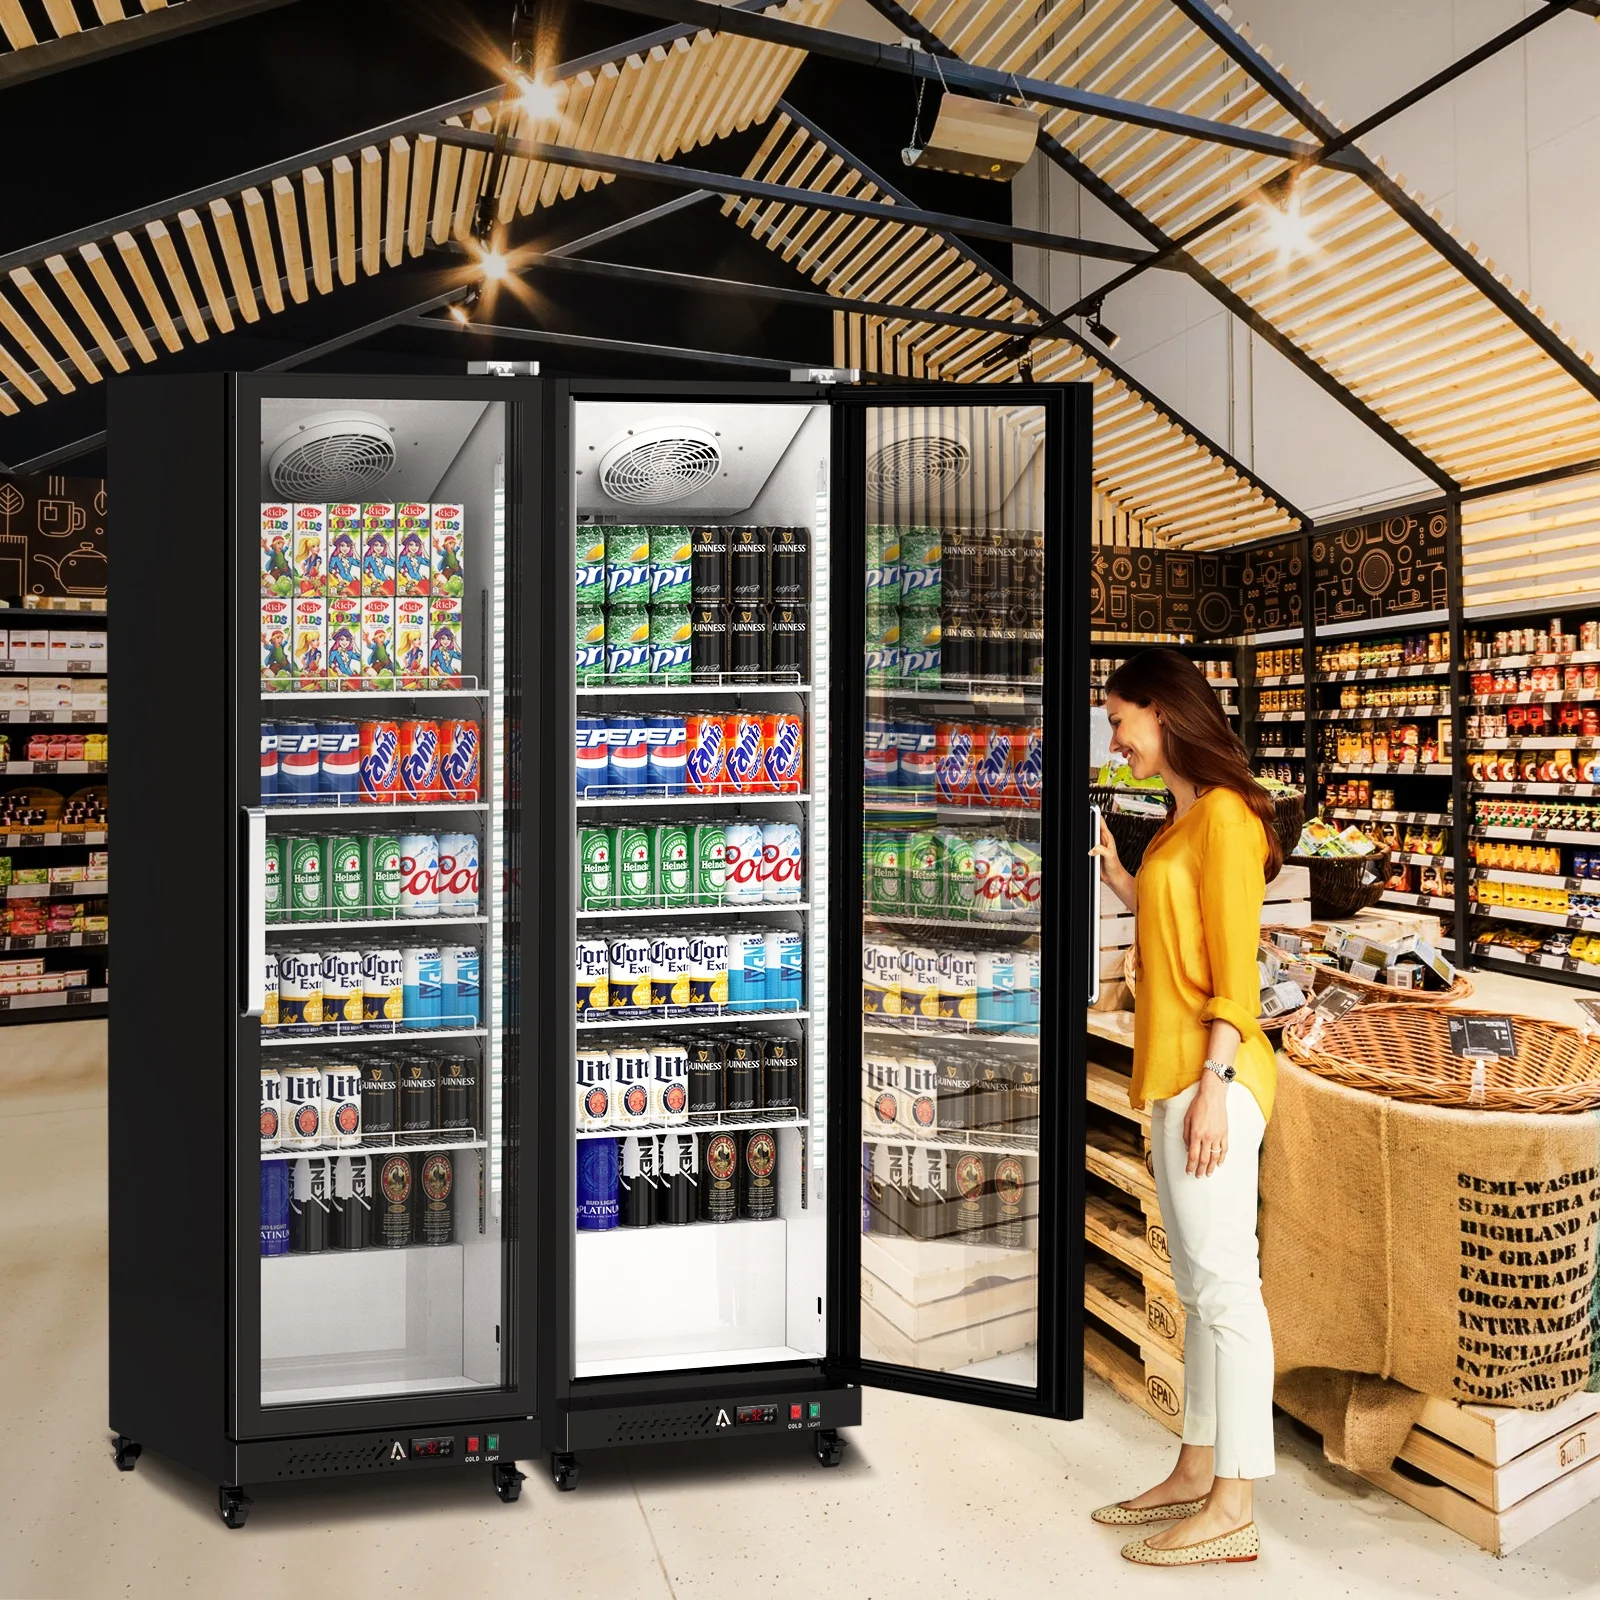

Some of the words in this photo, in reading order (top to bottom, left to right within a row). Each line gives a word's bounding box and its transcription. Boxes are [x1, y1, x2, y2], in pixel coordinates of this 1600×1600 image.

[266, 508, 283, 517] Rich
[300, 509, 318, 518] Rich
[335, 506, 353, 515] Rich
[369, 507, 387, 515] Rich
[404, 507, 422, 515] Rich
[438, 509, 455, 517] Rich
[300, 604, 317, 612] Rich
[334, 601, 353, 610] Rich
[368, 602, 385, 611] Rich
[403, 603, 420, 611] Rich
[436, 600, 453, 609] Rich
[360, 727, 398, 799] Fanta
[400, 727, 438, 798] Fanta
[440, 726, 477, 798] Fanta
[687, 724, 722, 792] Fanta
[726, 724, 761, 791] Fanta
[764, 724, 800, 790] Fanta
[936, 734, 974, 802] Fanta
[975, 735, 1013, 804] Fanta
[1458, 1195, 1584, 1219] SUMATERA
[1460, 1217, 1581, 1243] HIGHLAND
[1461, 1241, 1493, 1261] DP
[1499, 1243, 1576, 1266] GRADE
[1460, 1261, 1589, 1289] FAIRTRADE
[1458, 1288, 1565, 1310] ORGANIC
[1148, 1305, 1171, 1335] EPAL
[1152, 1381, 1175, 1412] EPAL
